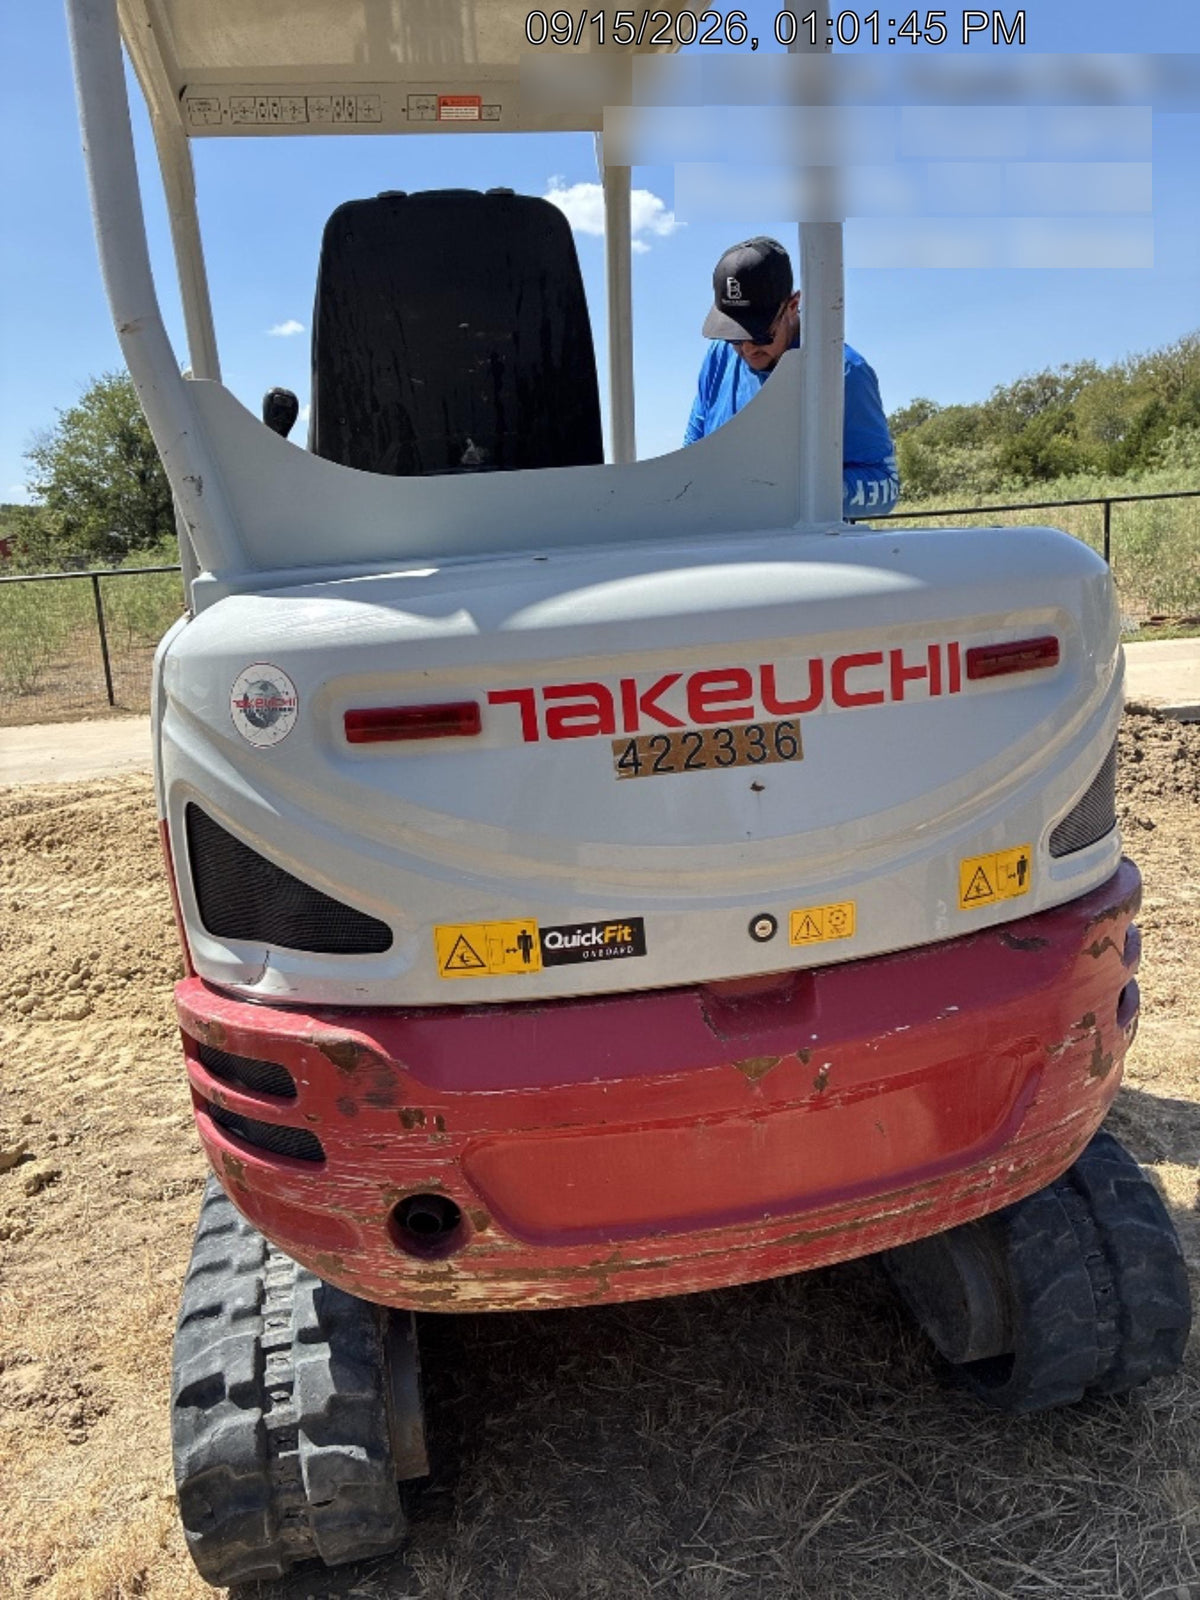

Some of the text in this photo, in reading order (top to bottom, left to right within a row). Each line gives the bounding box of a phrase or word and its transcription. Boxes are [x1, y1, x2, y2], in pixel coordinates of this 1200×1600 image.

[618, 721, 798, 776] 422336
[544, 924, 632, 949] QuickFit
[583, 945, 634, 960] ONBOARD
